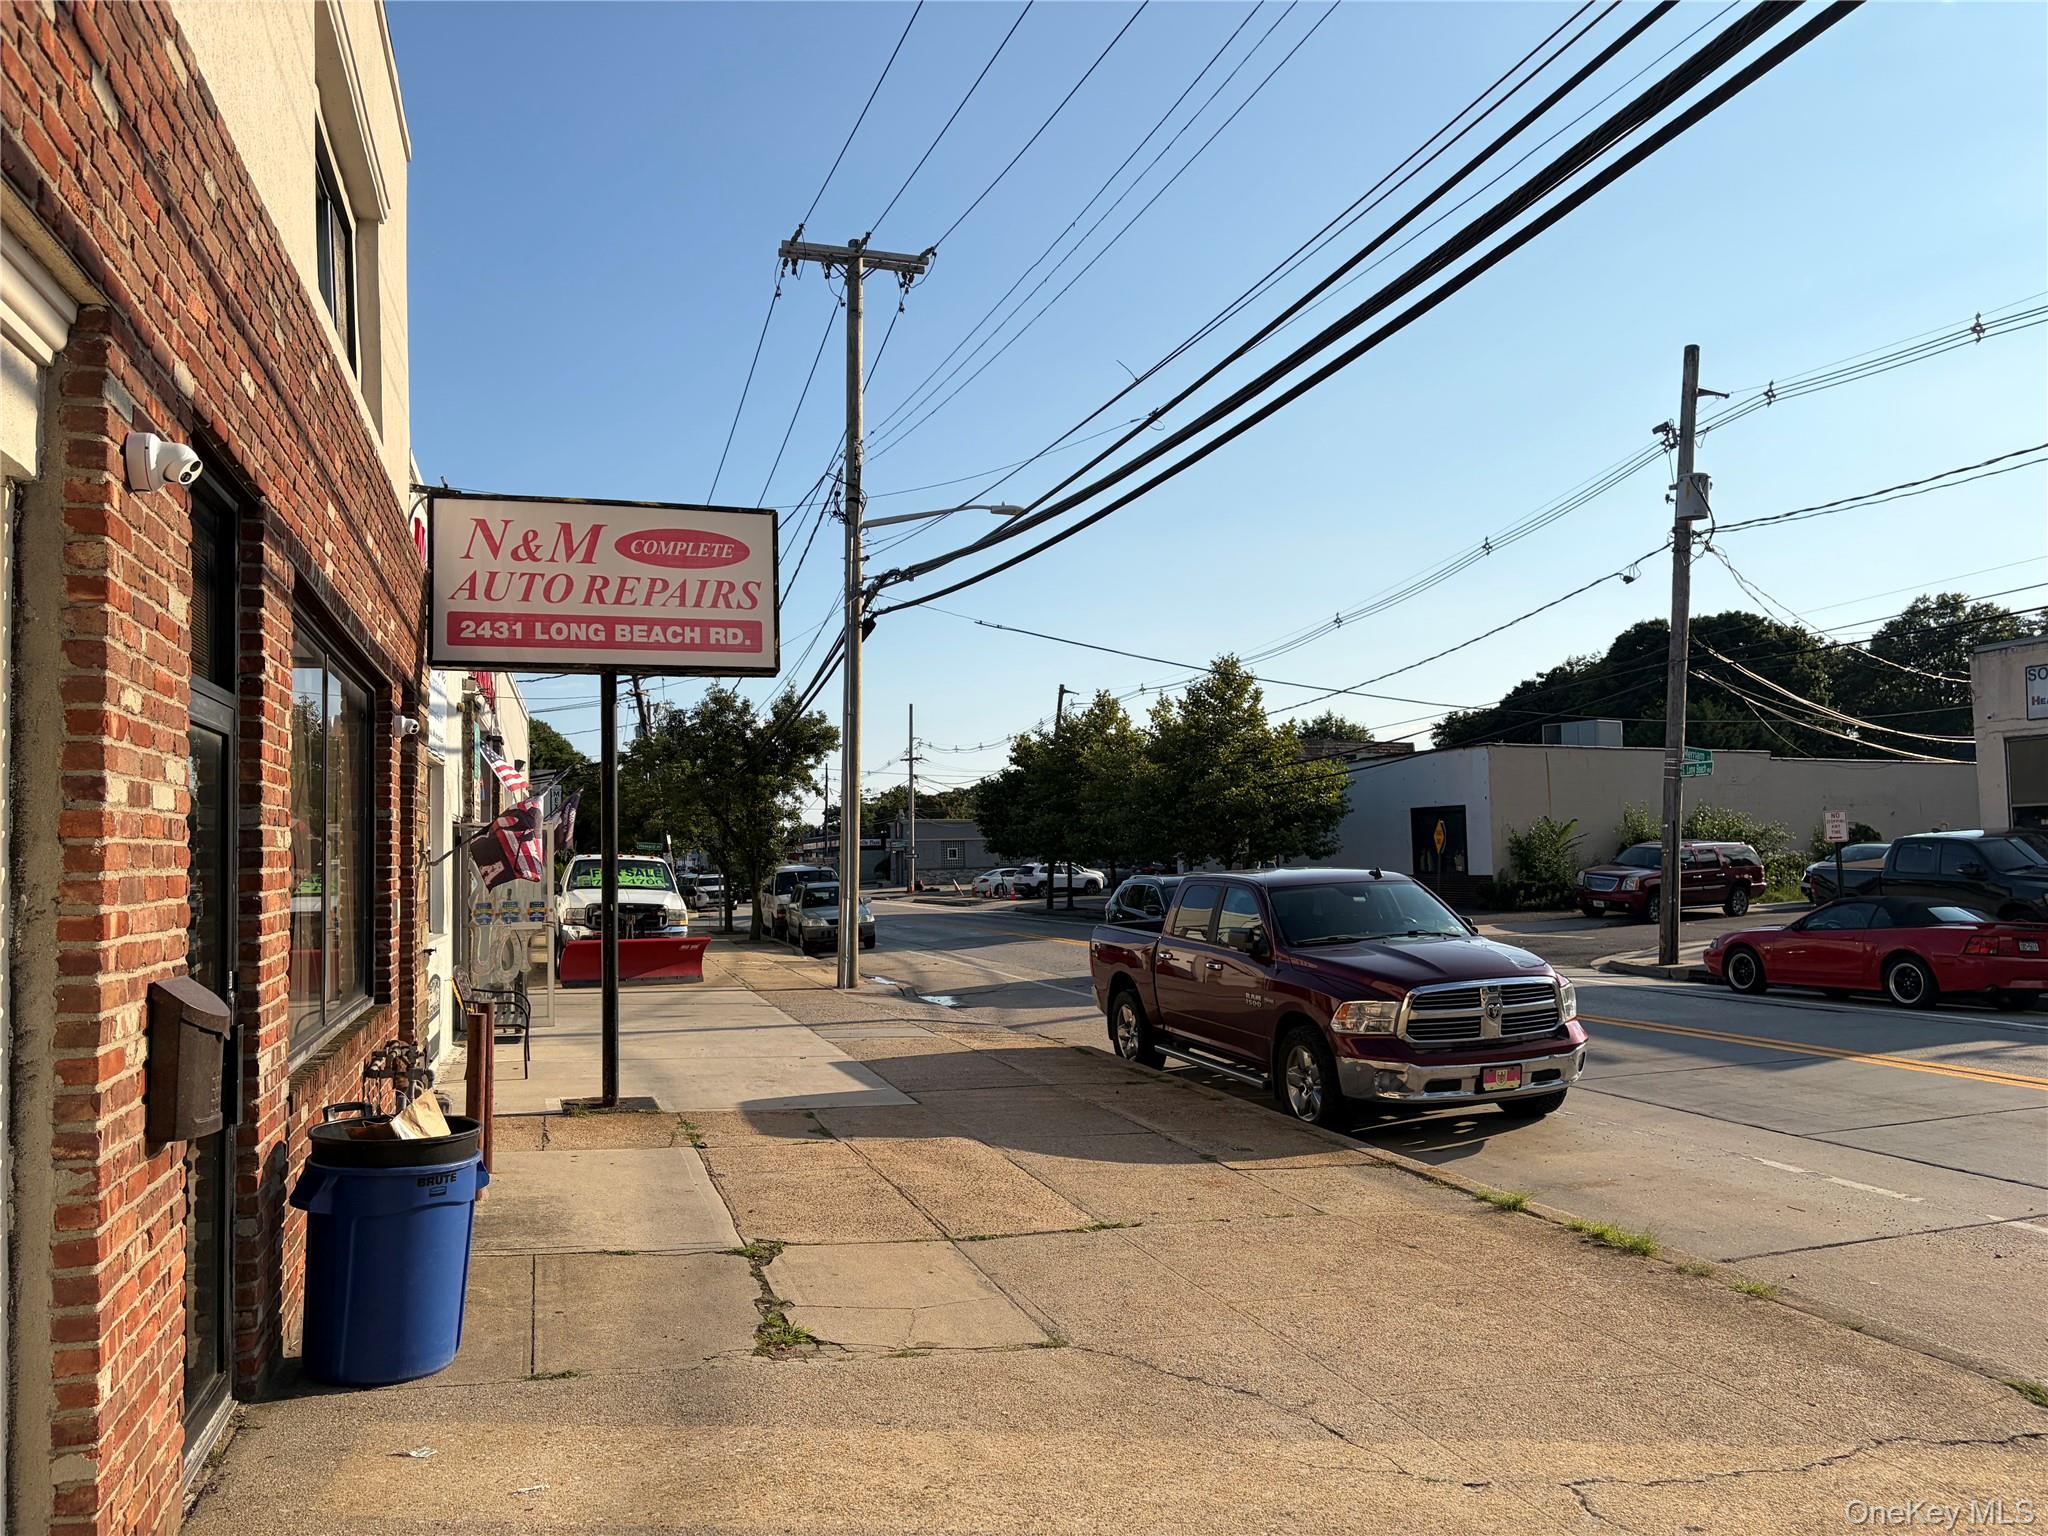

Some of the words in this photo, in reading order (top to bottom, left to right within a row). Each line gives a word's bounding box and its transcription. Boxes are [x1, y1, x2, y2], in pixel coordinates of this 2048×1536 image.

[460, 518, 608, 565] N&M
[630, 539, 735, 559] COMPLETE
[448, 570, 574, 604] AUTO
[582, 575, 762, 610] REPAIRS
[460, 620, 522, 640] 2431
[535, 621, 606, 642] LONG
[615, 624, 700, 644] BEACH
[709, 627, 751, 645] RD.
[625, 868, 663, 878] SALE
[1245, 992, 1262, 1001] RAM
[1245, 998, 1262, 1008] 1500
[417, 1172, 457, 1187] BRUTE
